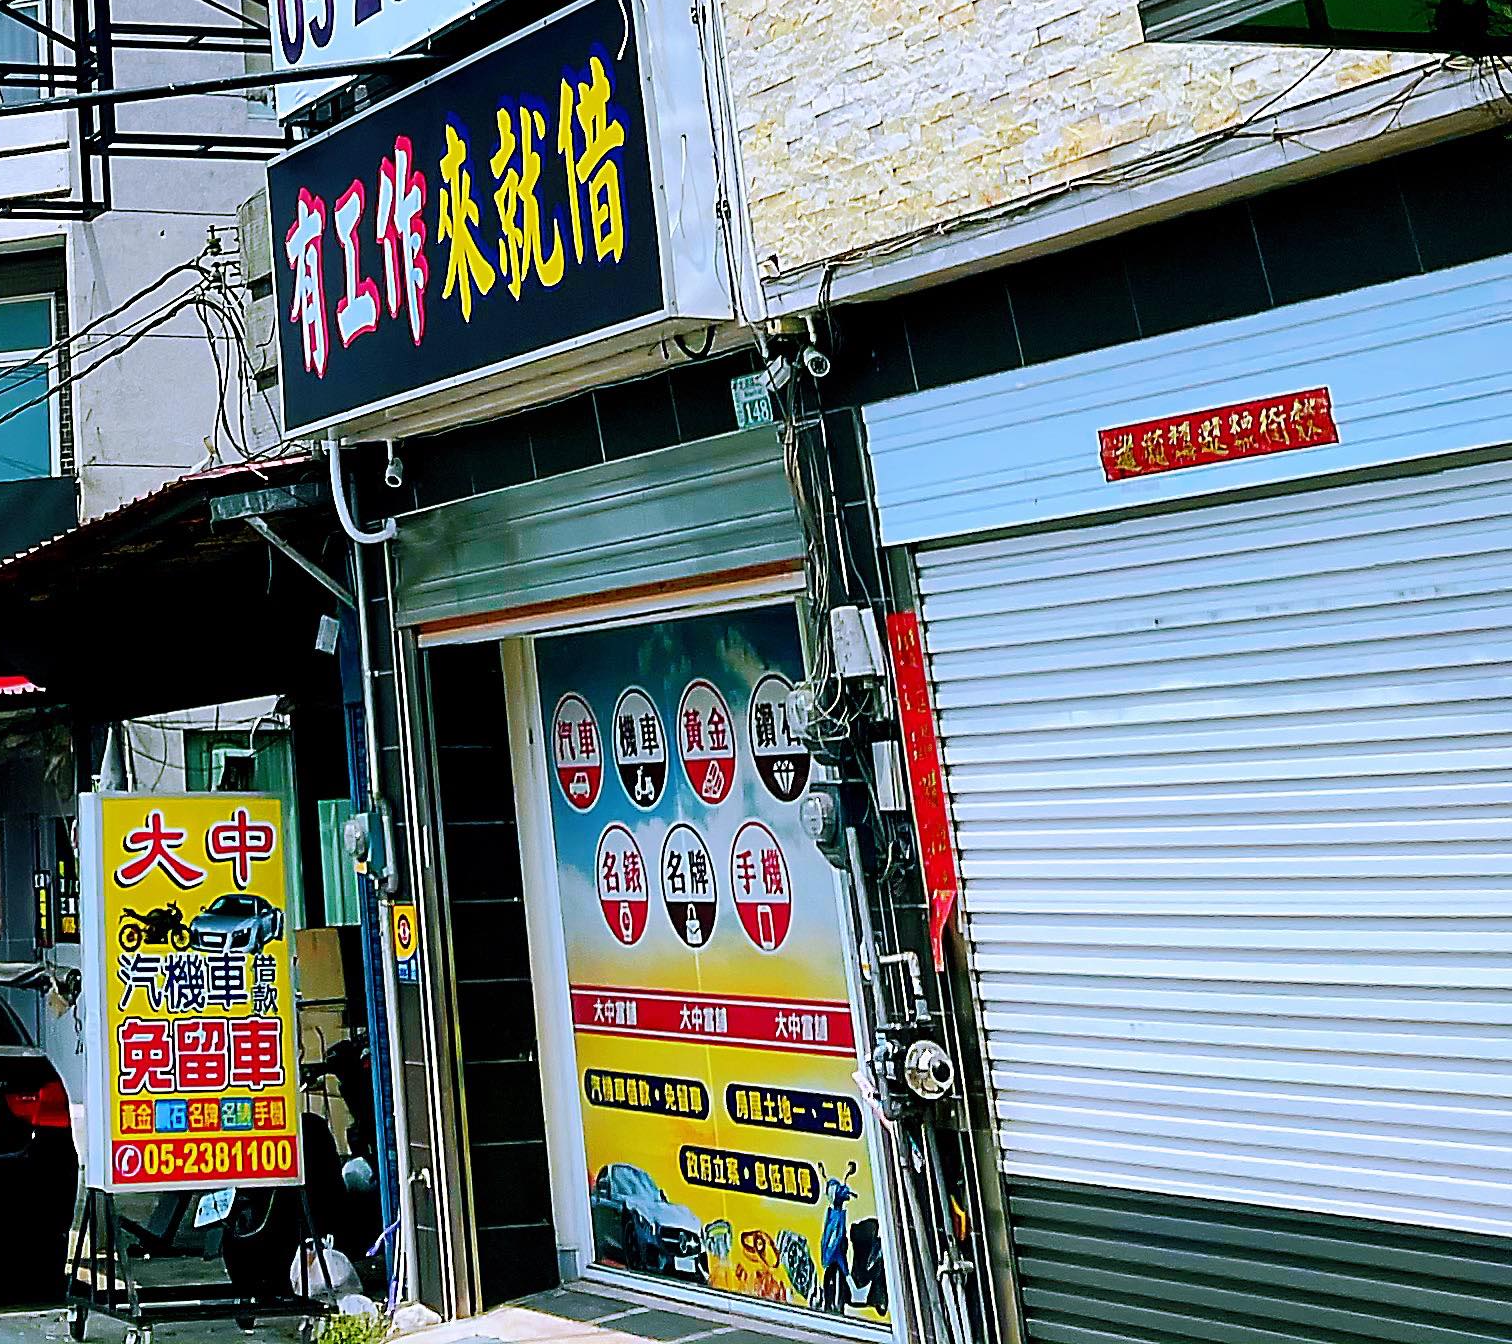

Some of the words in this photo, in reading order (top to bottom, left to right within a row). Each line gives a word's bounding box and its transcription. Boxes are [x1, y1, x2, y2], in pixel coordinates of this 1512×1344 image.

[285, 47, 628, 380] 有工作來就借
[557, 719, 596, 761] 汽車
[618, 712, 660, 758] 機車
[683, 707, 728, 753] 黃金
[115, 809, 278, 890] 大中
[667, 849, 709, 895] 名牌
[736, 848, 784, 896] 手機
[118, 953, 248, 1013] 汽機車
[251, 953, 279, 1014] 借款
[118, 1017, 285, 1093] 免留車
[143, 1140, 292, 1175] 05-2381100
